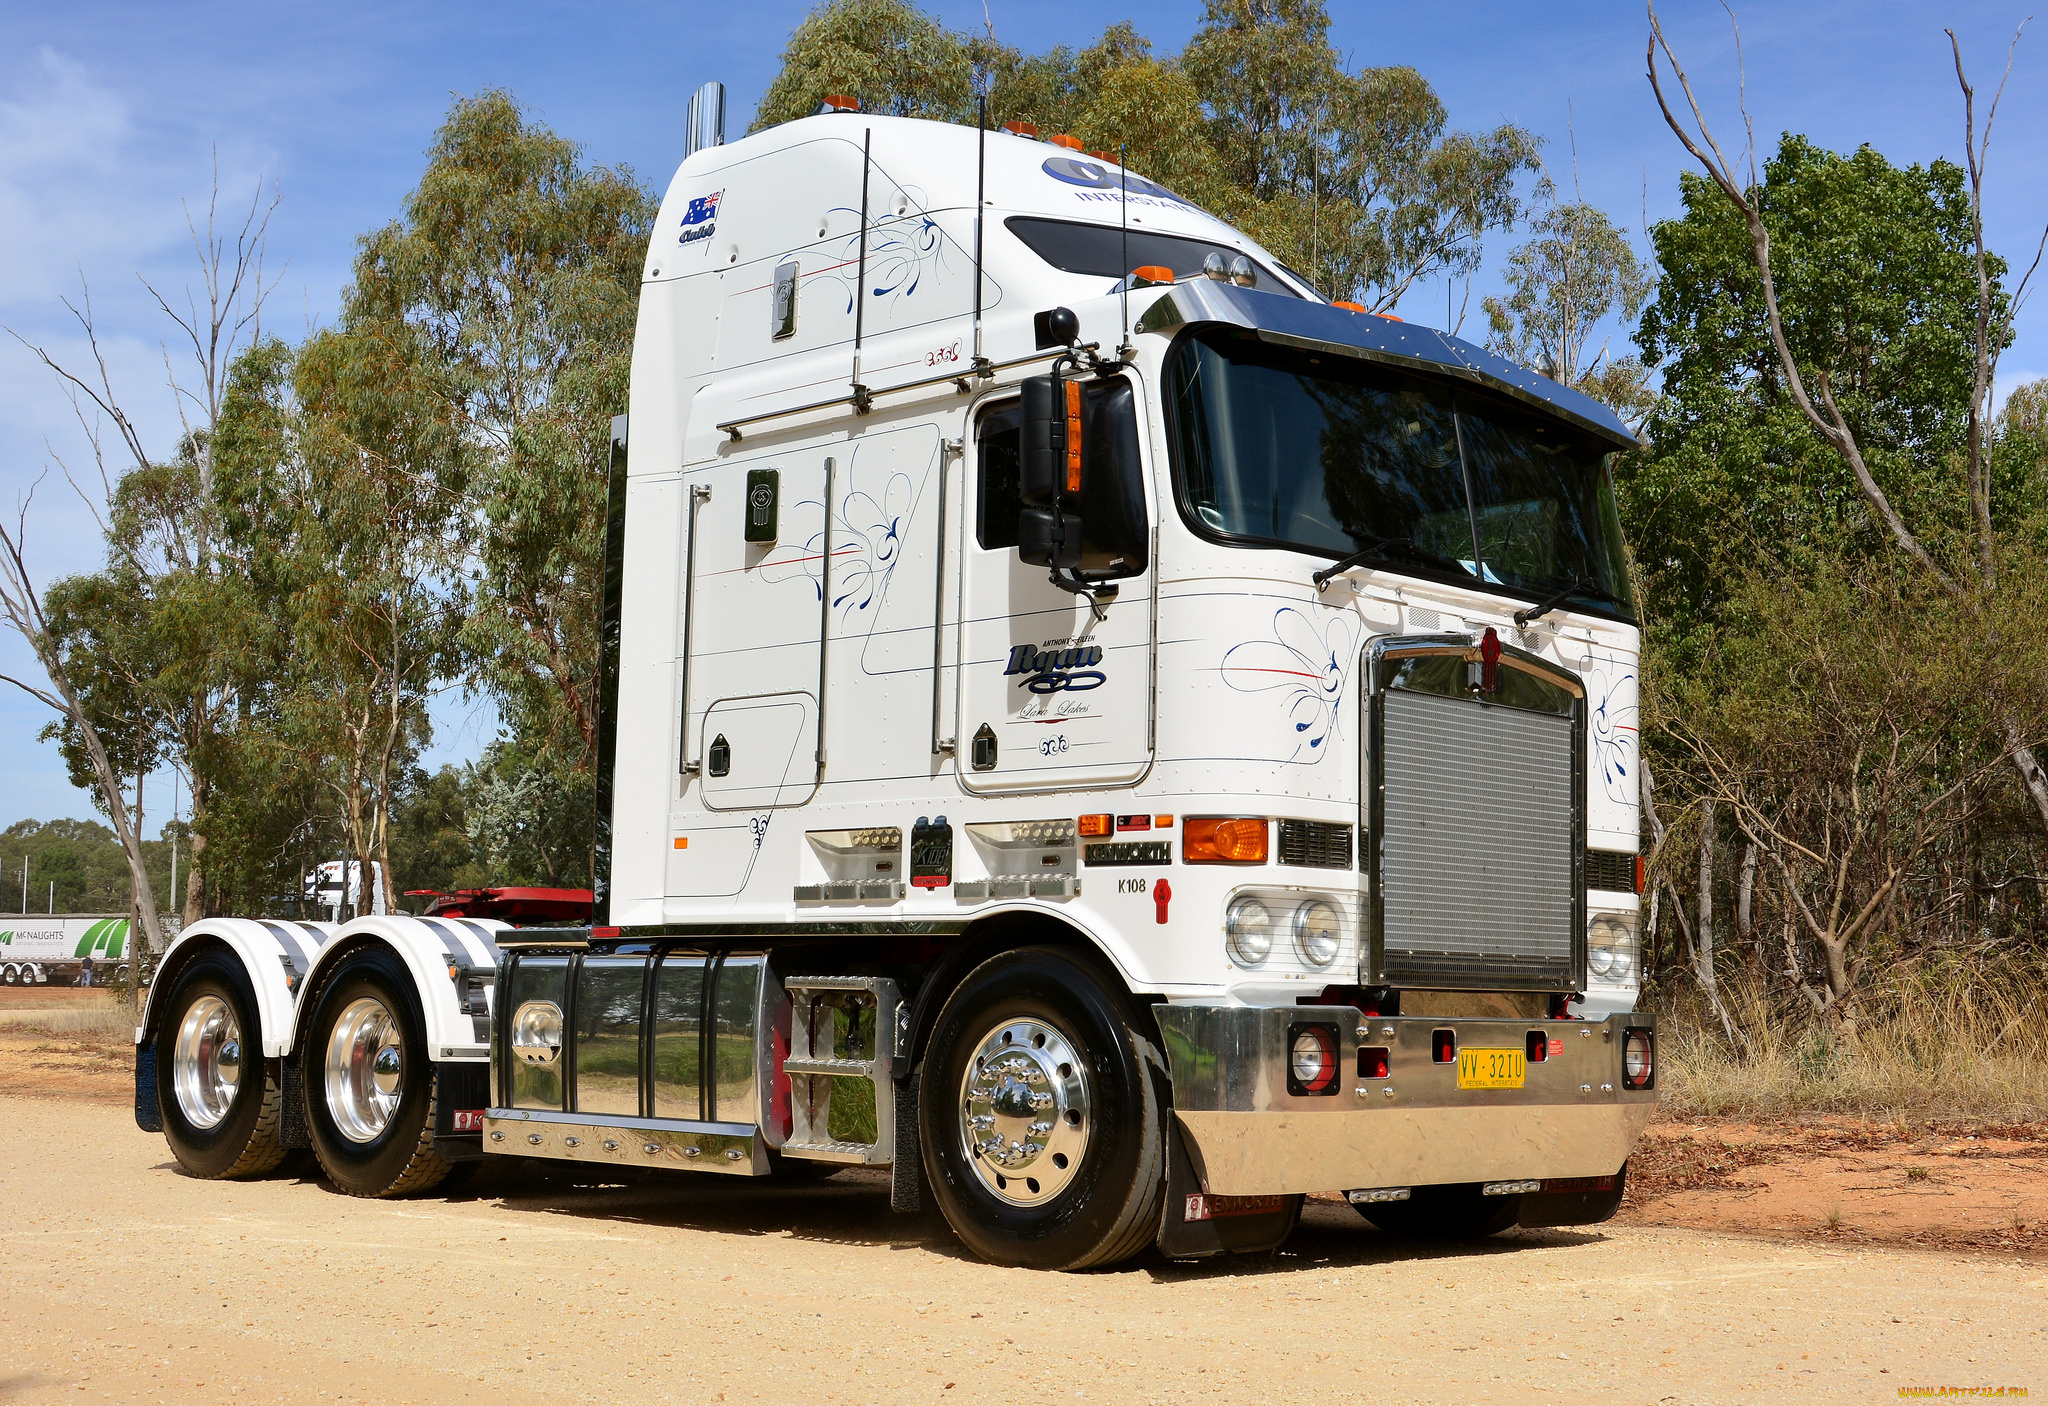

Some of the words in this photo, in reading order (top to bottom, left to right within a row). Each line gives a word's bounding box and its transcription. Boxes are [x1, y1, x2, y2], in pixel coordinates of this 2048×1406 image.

[1074, 192, 1197, 216] INTERSTATE
[1042, 637, 1070, 647] ANTHONY
[1077, 635, 1096, 644] EILEEN
[1003, 643, 1107, 694] Ryan
[1054, 700, 1091, 716] Lakes
[916, 846, 947, 865] K108
[1085, 842, 1169, 861] KENWORTH
[1118, 878, 1146, 893] K108
[16, 930, 64, 940] McNAUGHTS
